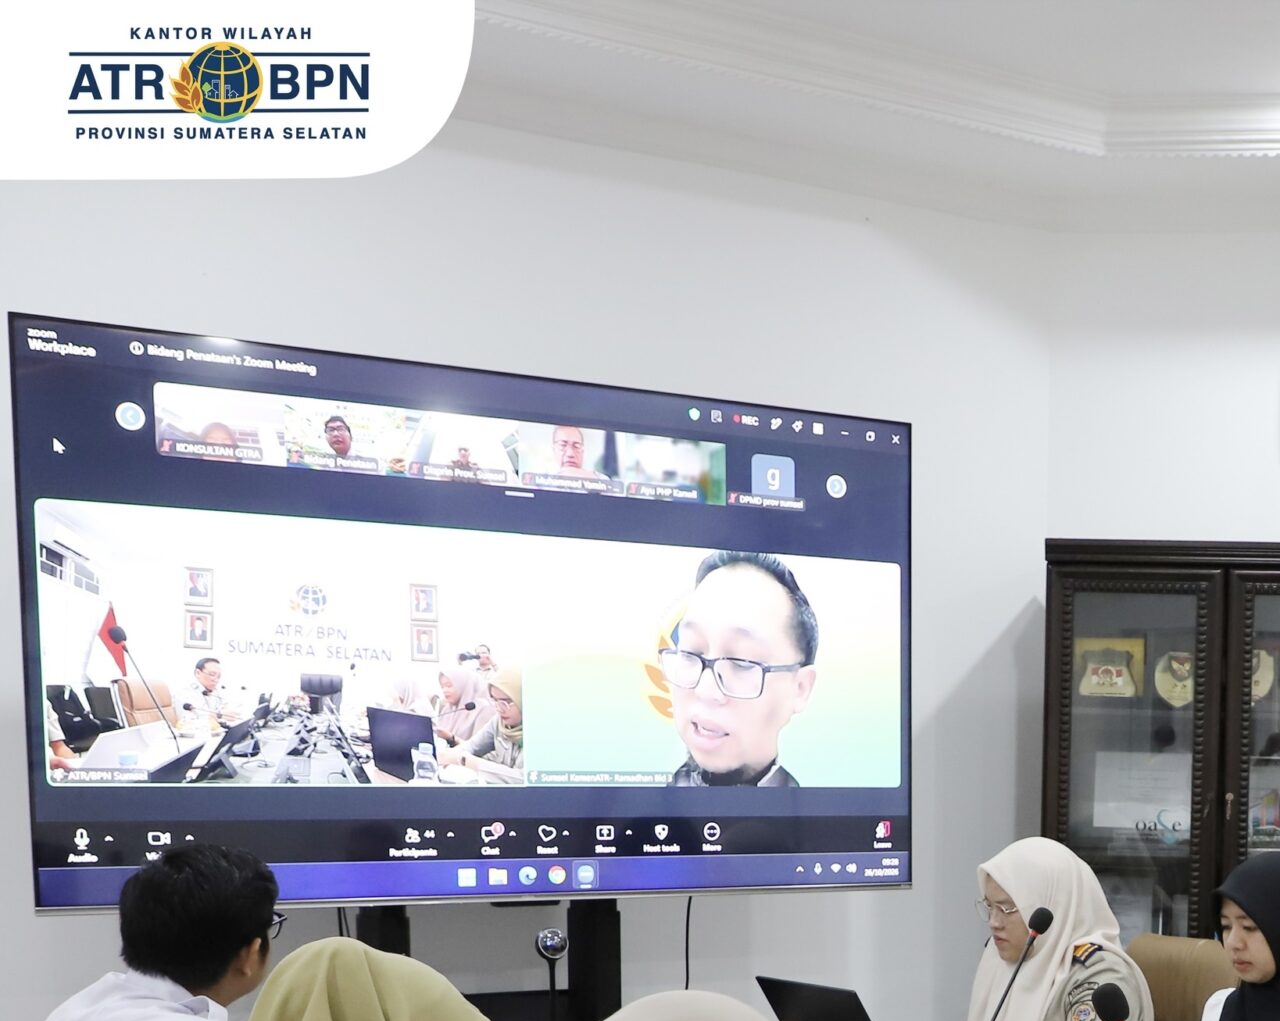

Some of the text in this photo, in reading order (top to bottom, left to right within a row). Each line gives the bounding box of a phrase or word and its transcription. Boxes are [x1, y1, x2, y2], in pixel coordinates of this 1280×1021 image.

[27, 327, 58, 340] zoom
[27, 338, 97, 358] Workplace
[147, 343, 317, 377] Bidang Penataan's Zoom Meeting
[741, 414, 760, 427] REC
[175, 442, 234, 459] KONSULTAN
[304, 453, 337, 469] Bidang
[766, 468, 781, 491] g
[227, 639, 392, 662] SUMATERA SELATAN
[388, 847, 439, 859] Participants
[480, 845, 501, 856] Chat
[594, 844, 617, 854] Share
[702, 843, 722, 852] More
[67, 852, 99, 863] Audio
